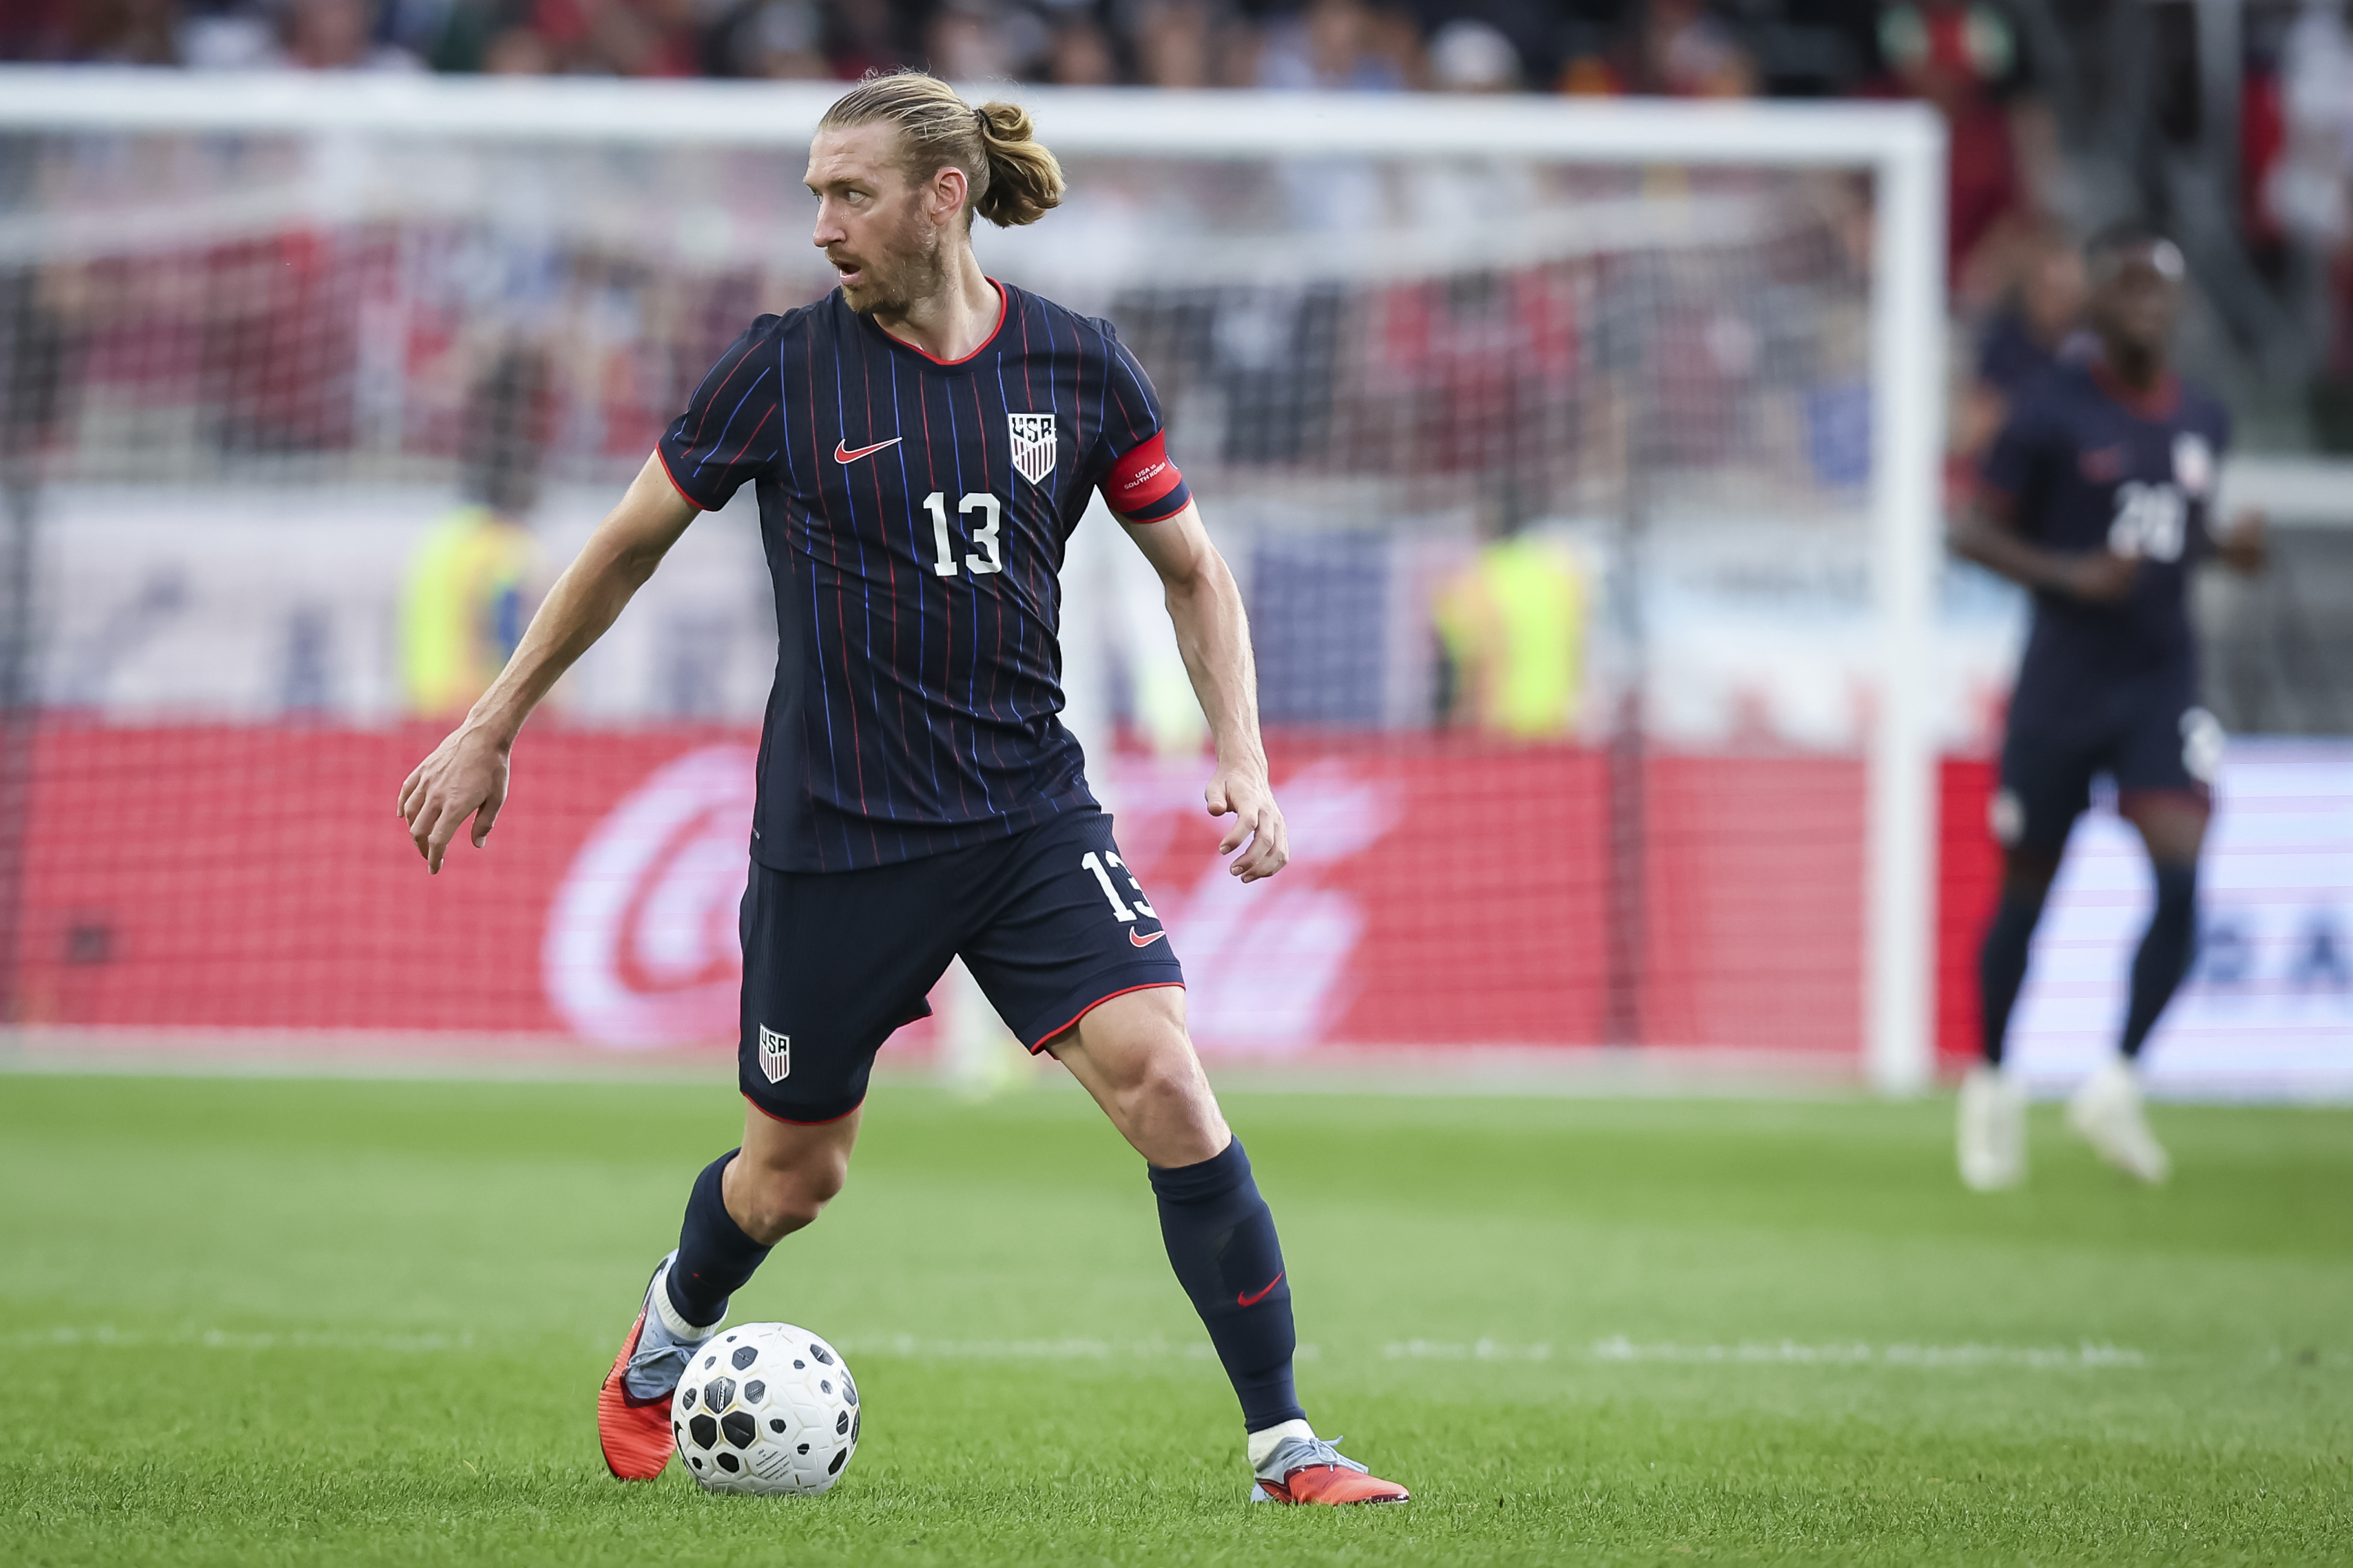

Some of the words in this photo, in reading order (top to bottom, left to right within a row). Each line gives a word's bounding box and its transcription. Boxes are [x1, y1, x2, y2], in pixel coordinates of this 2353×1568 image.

[1012, 417, 1052, 443] USA
[1123, 474, 1150, 490] SOUTH
[1149, 462, 1166, 477] KOREA
[1134, 468, 1150, 479] USA
[923, 492, 1002, 576] 13
[1081, 850, 1159, 922] 13
[761, 1028, 787, 1054] USA
